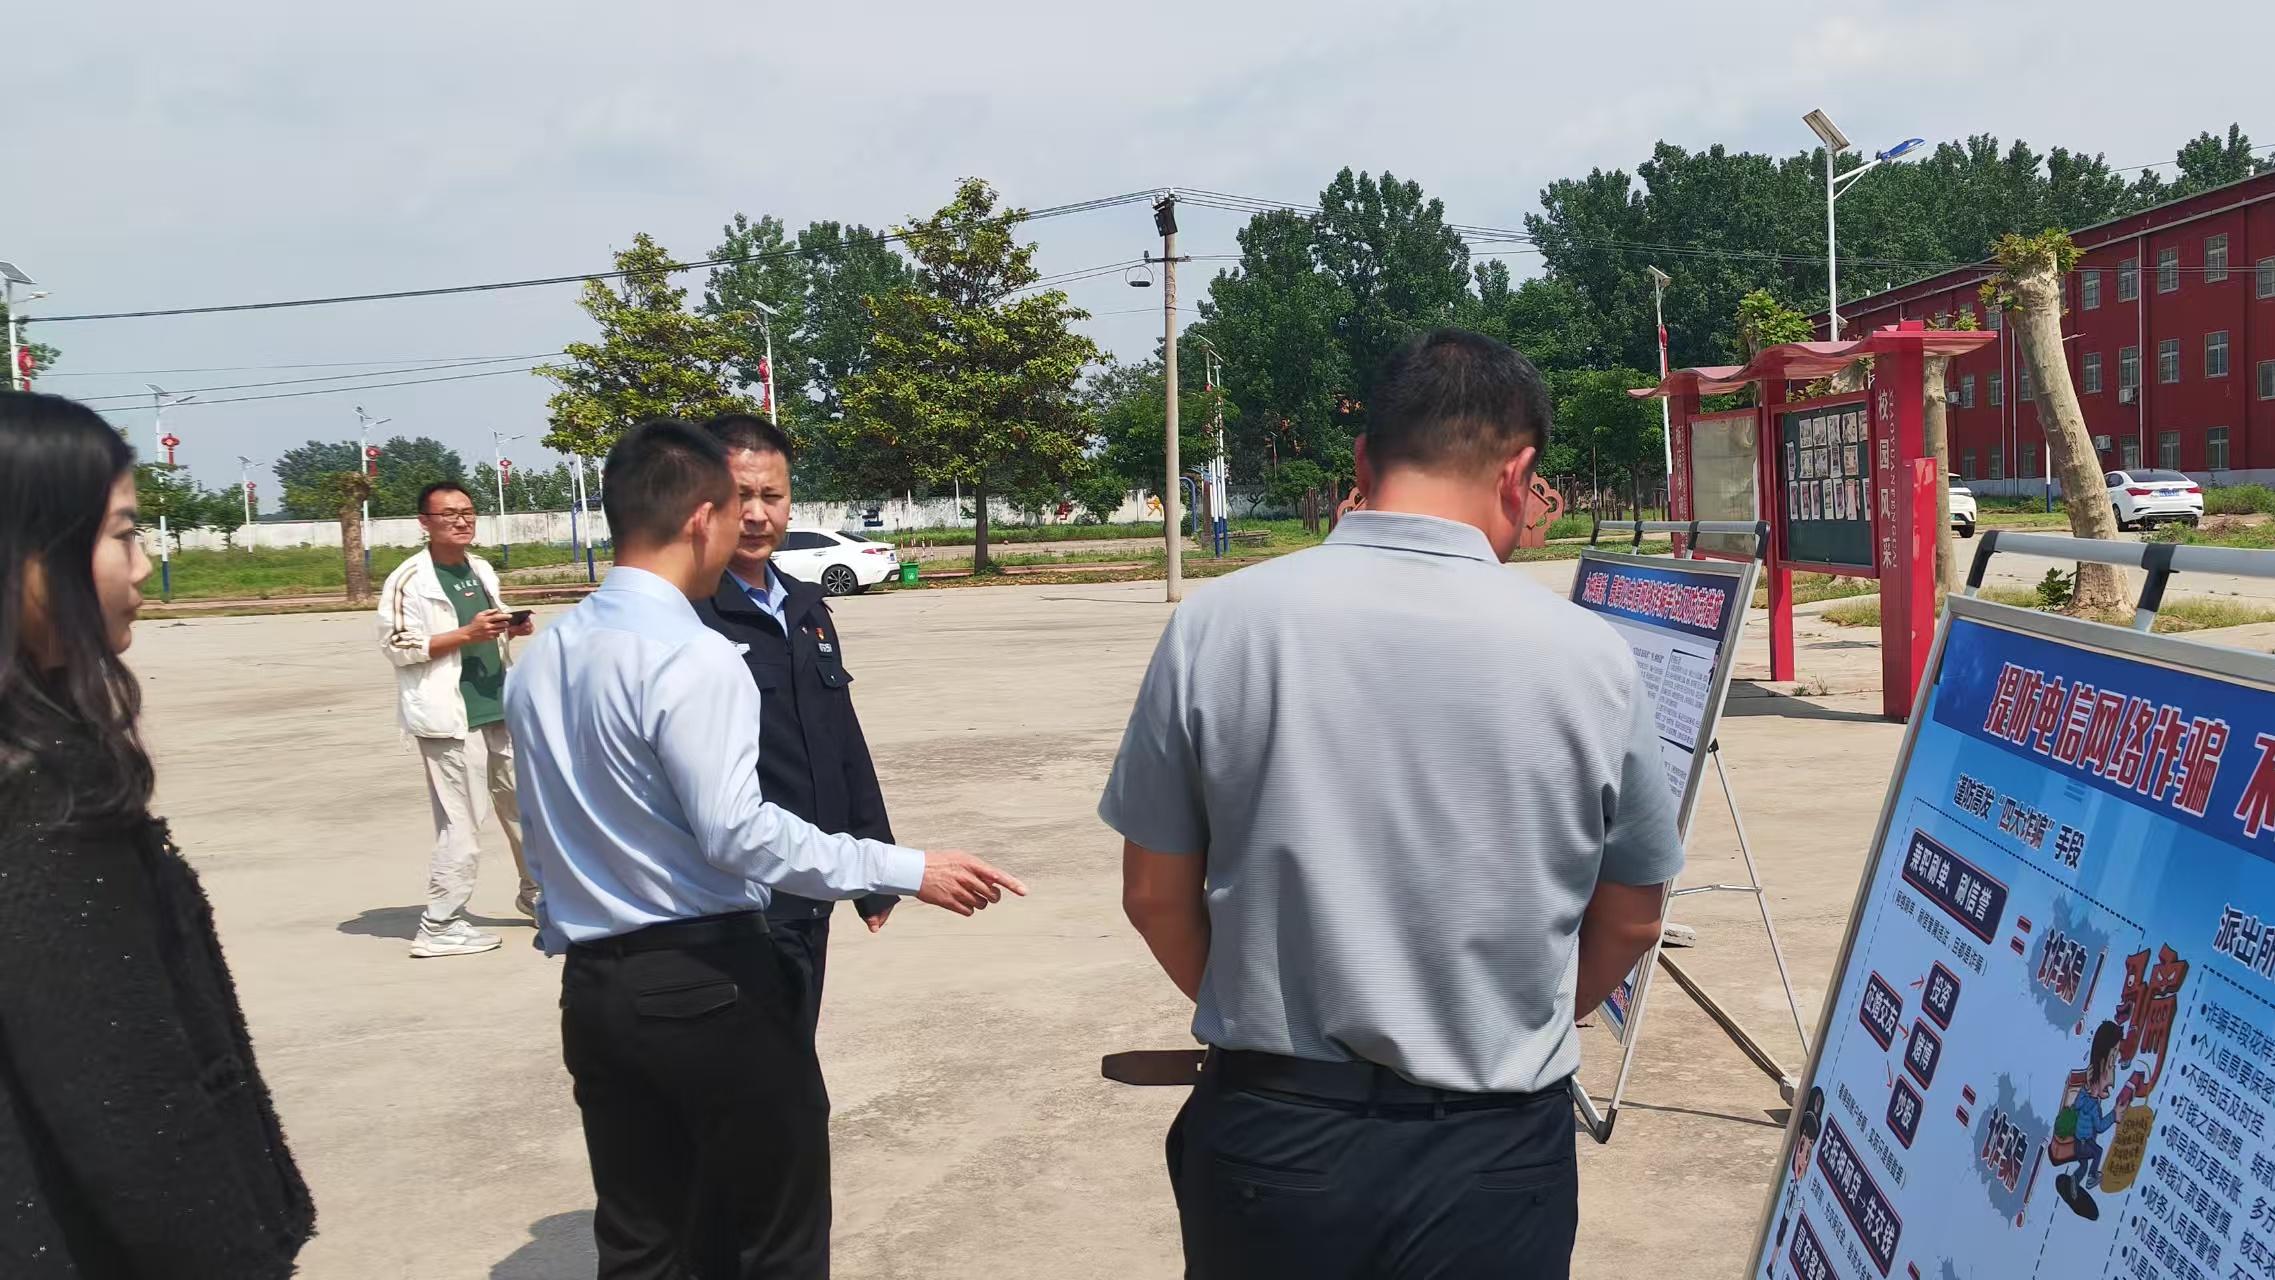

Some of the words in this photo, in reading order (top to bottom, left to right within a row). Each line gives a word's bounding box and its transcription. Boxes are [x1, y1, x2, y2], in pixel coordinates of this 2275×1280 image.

[1878, 390, 1892, 569] 校园风采
[453, 579, 479, 592] NIKE
[1982, 661, 2230, 816] 提防电信网络诈骗
[1908, 842, 1993, 922] 兼职刷单、刷信誉
[2212, 902, 2275, 983] 派出所
[1865, 983, 1898, 1038] 征婚交友
[1929, 974, 1953, 1013] 投资
[1911, 1031, 1934, 1071] 赌博
[2205, 1000, 2275, 1067] 诈骗手段花样
[1894, 1088, 1915, 1130] 炒股
[2125, 1246, 2162, 1280] 凡是网
[2135, 1215, 2209, 1280] 凡是客服索要
